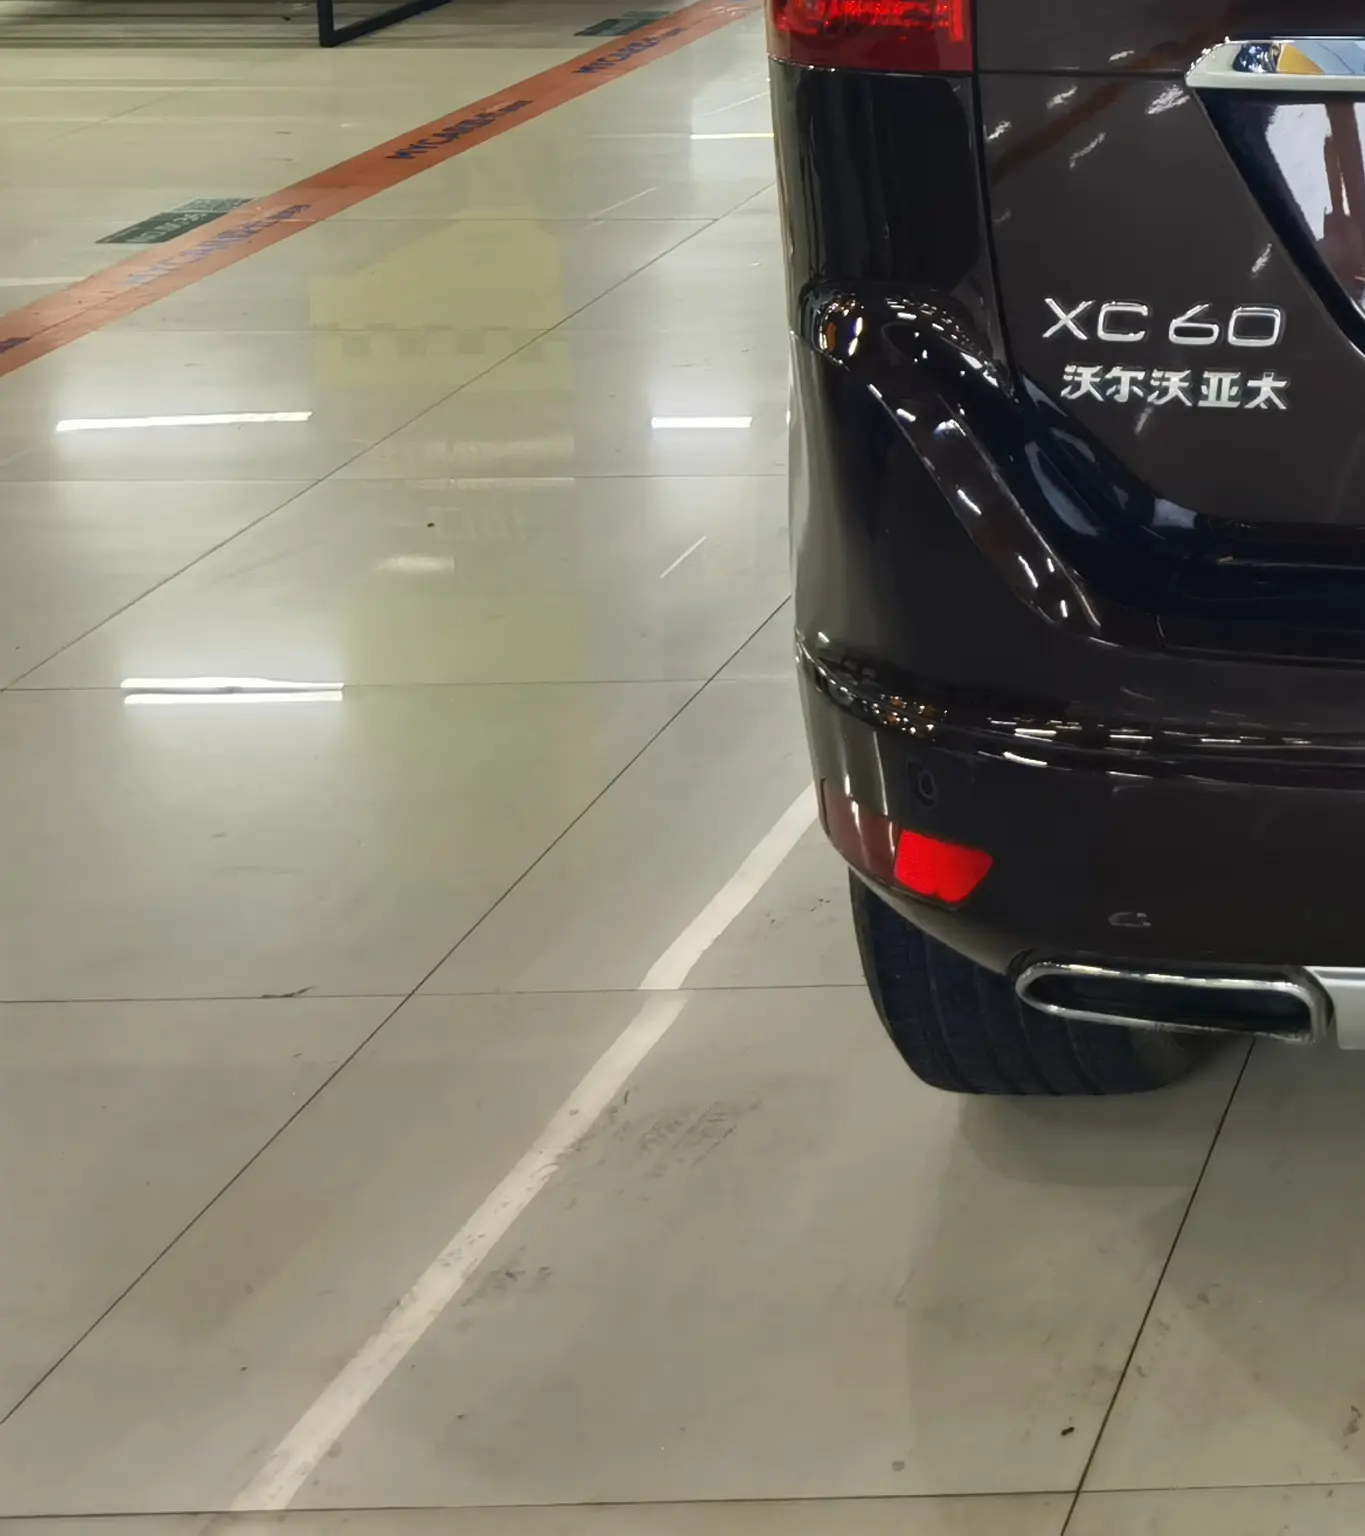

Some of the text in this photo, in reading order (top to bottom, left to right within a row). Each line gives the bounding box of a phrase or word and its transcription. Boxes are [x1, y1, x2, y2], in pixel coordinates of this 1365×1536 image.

[1042, 298, 1281, 347] XC 60
[1060, 364, 1288, 410] 沃尔沃亚太
